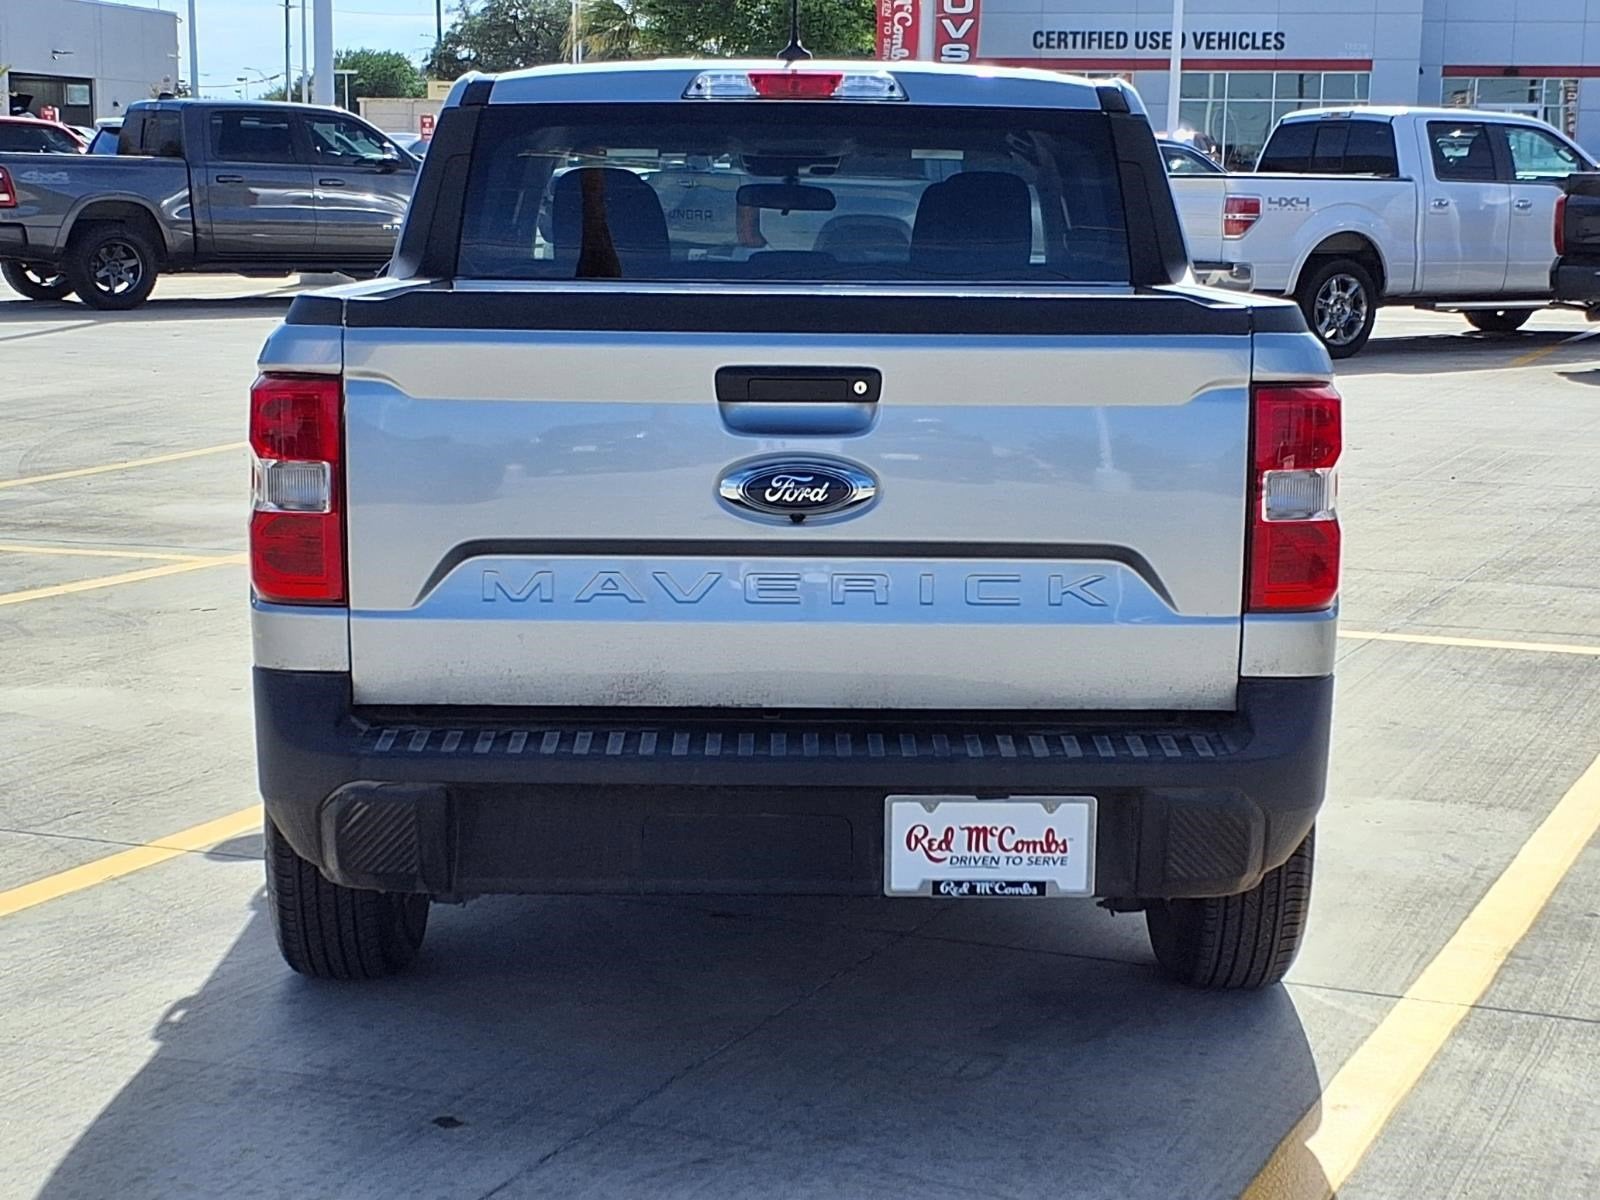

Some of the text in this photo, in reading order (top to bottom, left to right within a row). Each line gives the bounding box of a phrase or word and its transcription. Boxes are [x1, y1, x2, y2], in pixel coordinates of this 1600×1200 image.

[884, 21, 892, 35] TO
[1032, 30, 1129, 50] CERTIFIED
[1192, 31, 1286, 51] VEHICLES
[667, 208, 713, 221] UNDRA
[764, 474, 830, 502] Ford
[482, 570, 1109, 607] MAVERICK
[905, 823, 1068, 864] Red McCombs
[949, 855, 1068, 867] DRIVEN TO SERVE
[939, 880, 1038, 897] Red McCombs
